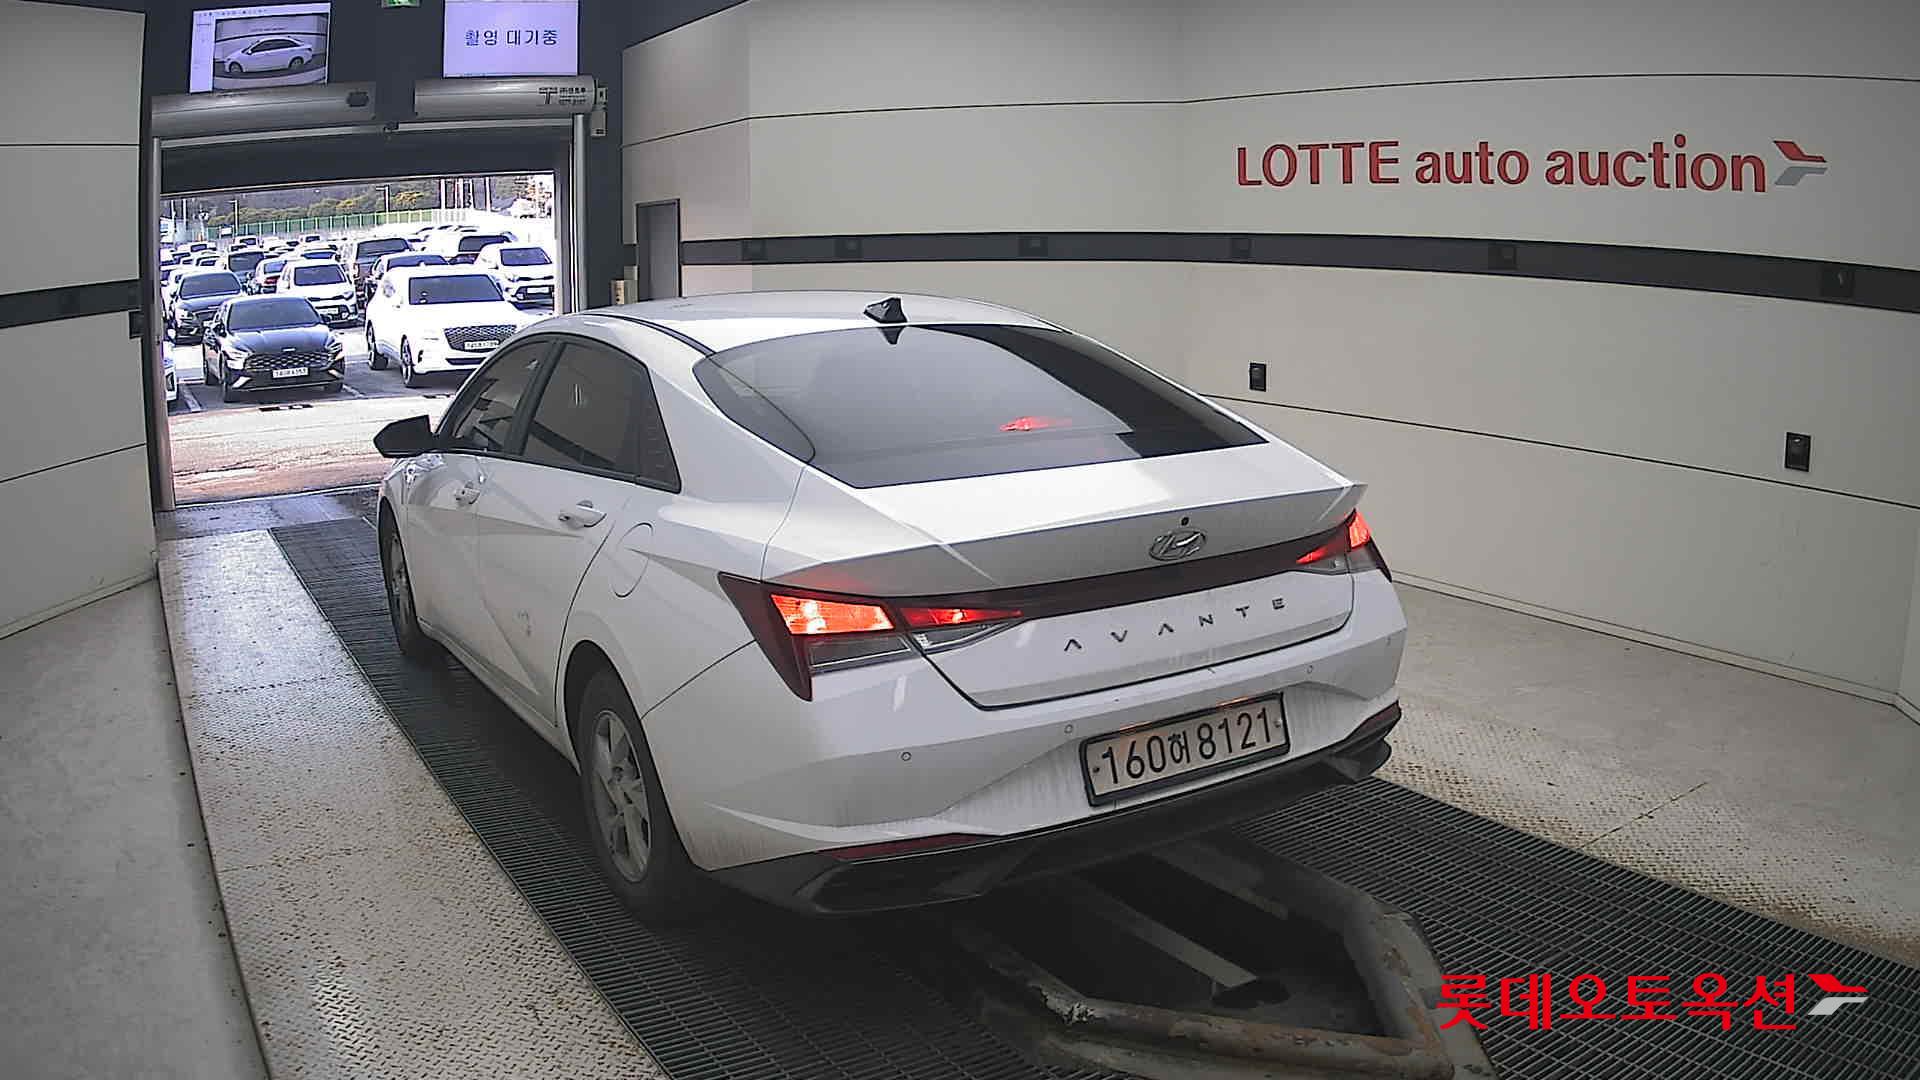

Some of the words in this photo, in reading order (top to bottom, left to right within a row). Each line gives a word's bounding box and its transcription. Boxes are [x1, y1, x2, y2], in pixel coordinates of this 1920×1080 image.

[506, 29, 558, 46] 대기중
[1237, 140, 1400, 187] LOTTE
[1415, 141, 1529, 185] auto
[1544, 134, 1767, 192] auction
[1063, 598, 1285, 652] AVANTE
